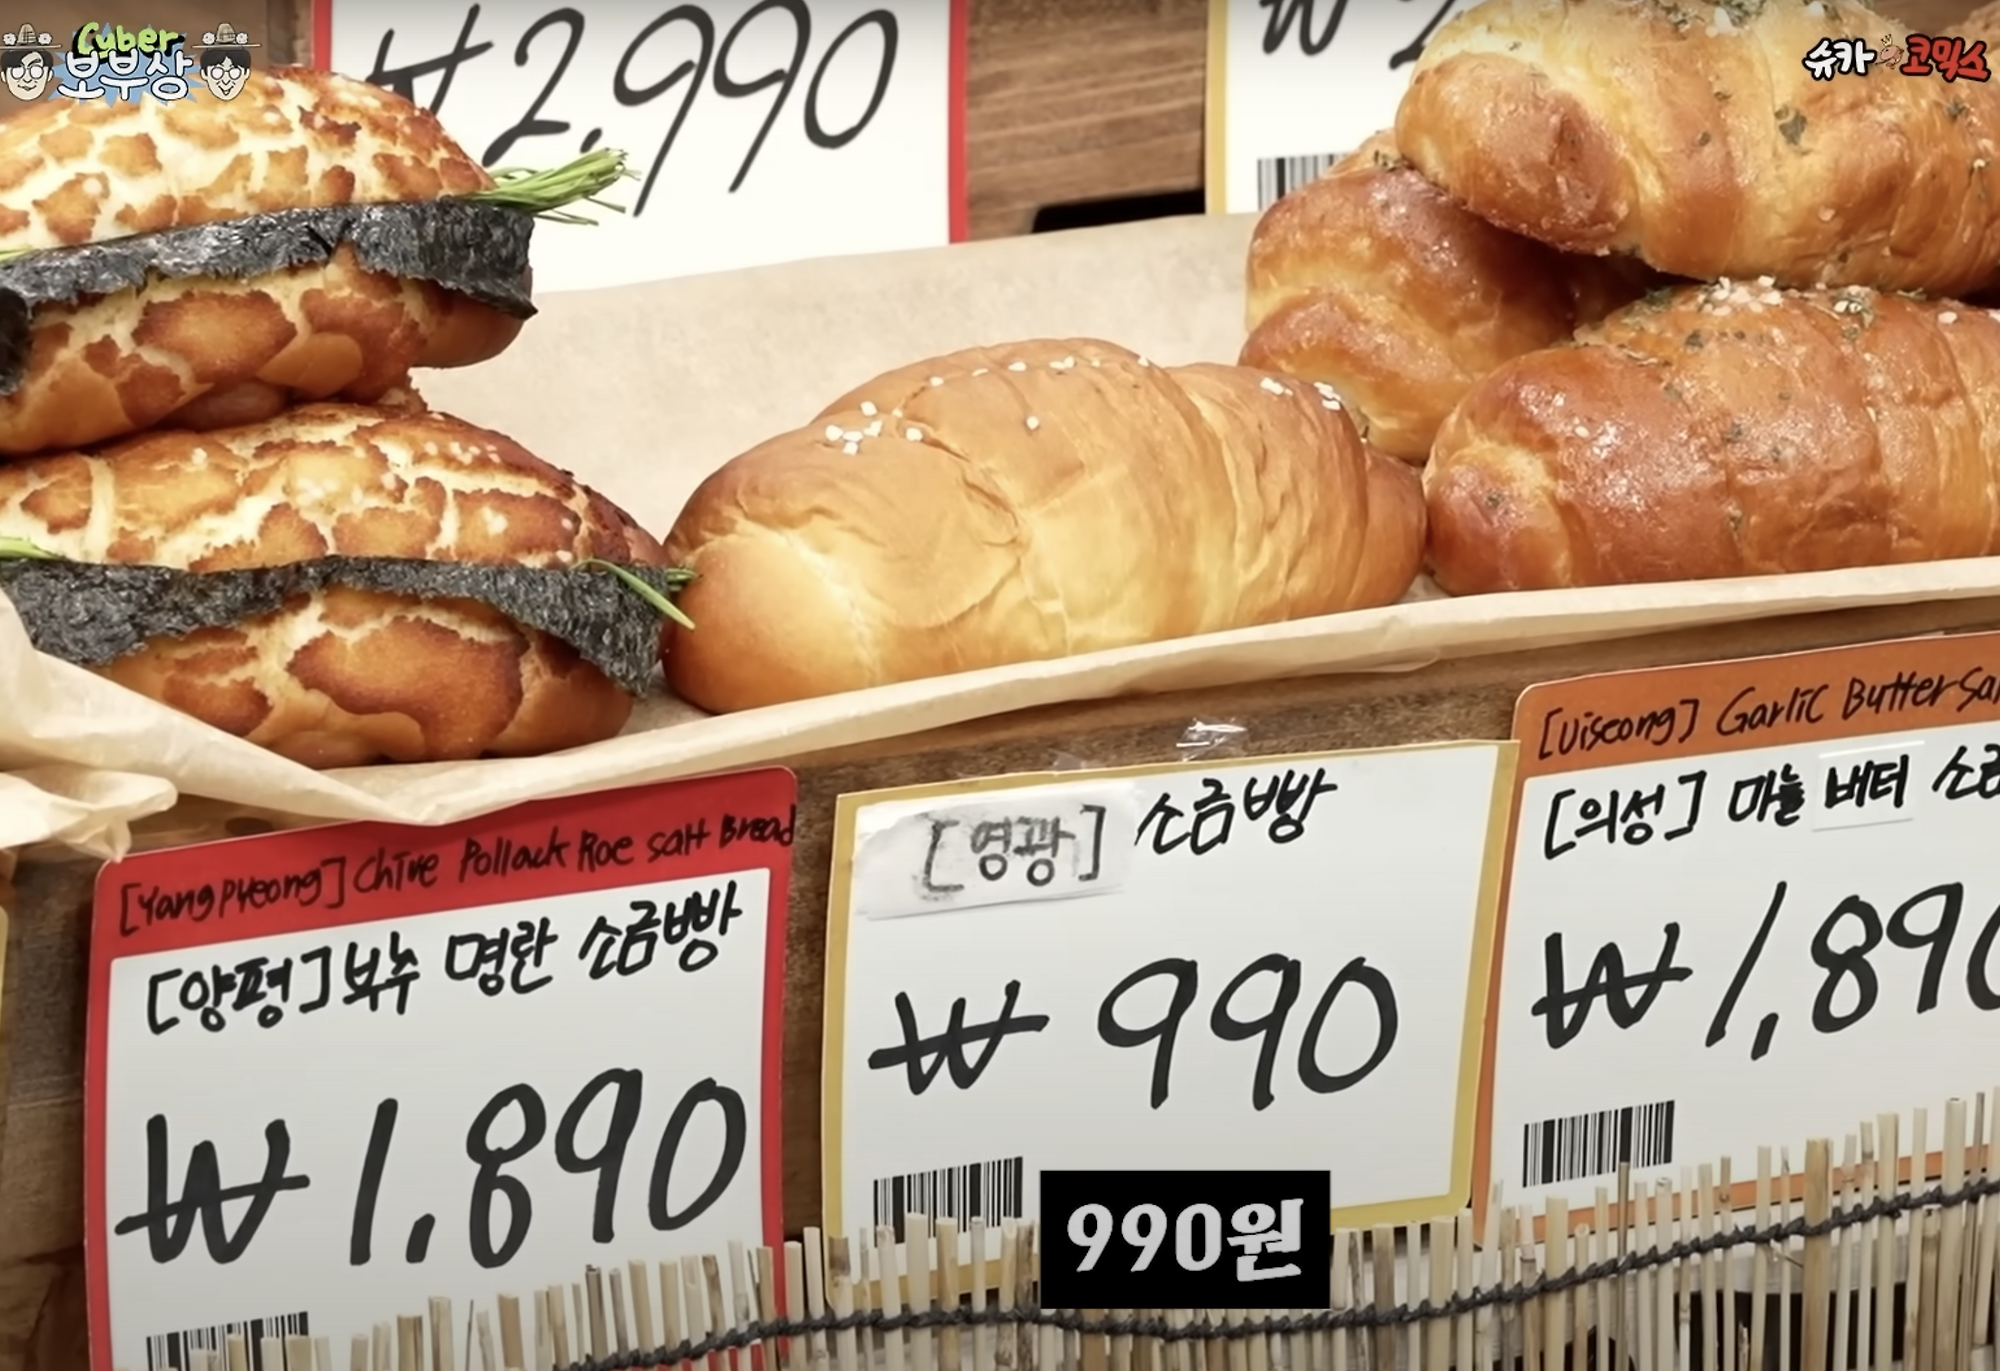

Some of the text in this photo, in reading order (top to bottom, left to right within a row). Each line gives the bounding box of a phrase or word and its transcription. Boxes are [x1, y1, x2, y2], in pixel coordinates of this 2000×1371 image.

[577, 829, 635, 873] Roe
[921, 767, 1338, 892] [영광] 소금빵
[1544, 769, 1708, 860] [의성]
[1727, 762, 1805, 827] 마늘
[1823, 753, 1910, 809] 버터
[444, 916, 559, 997] 명란
[578, 879, 743, 980] 소금빵
